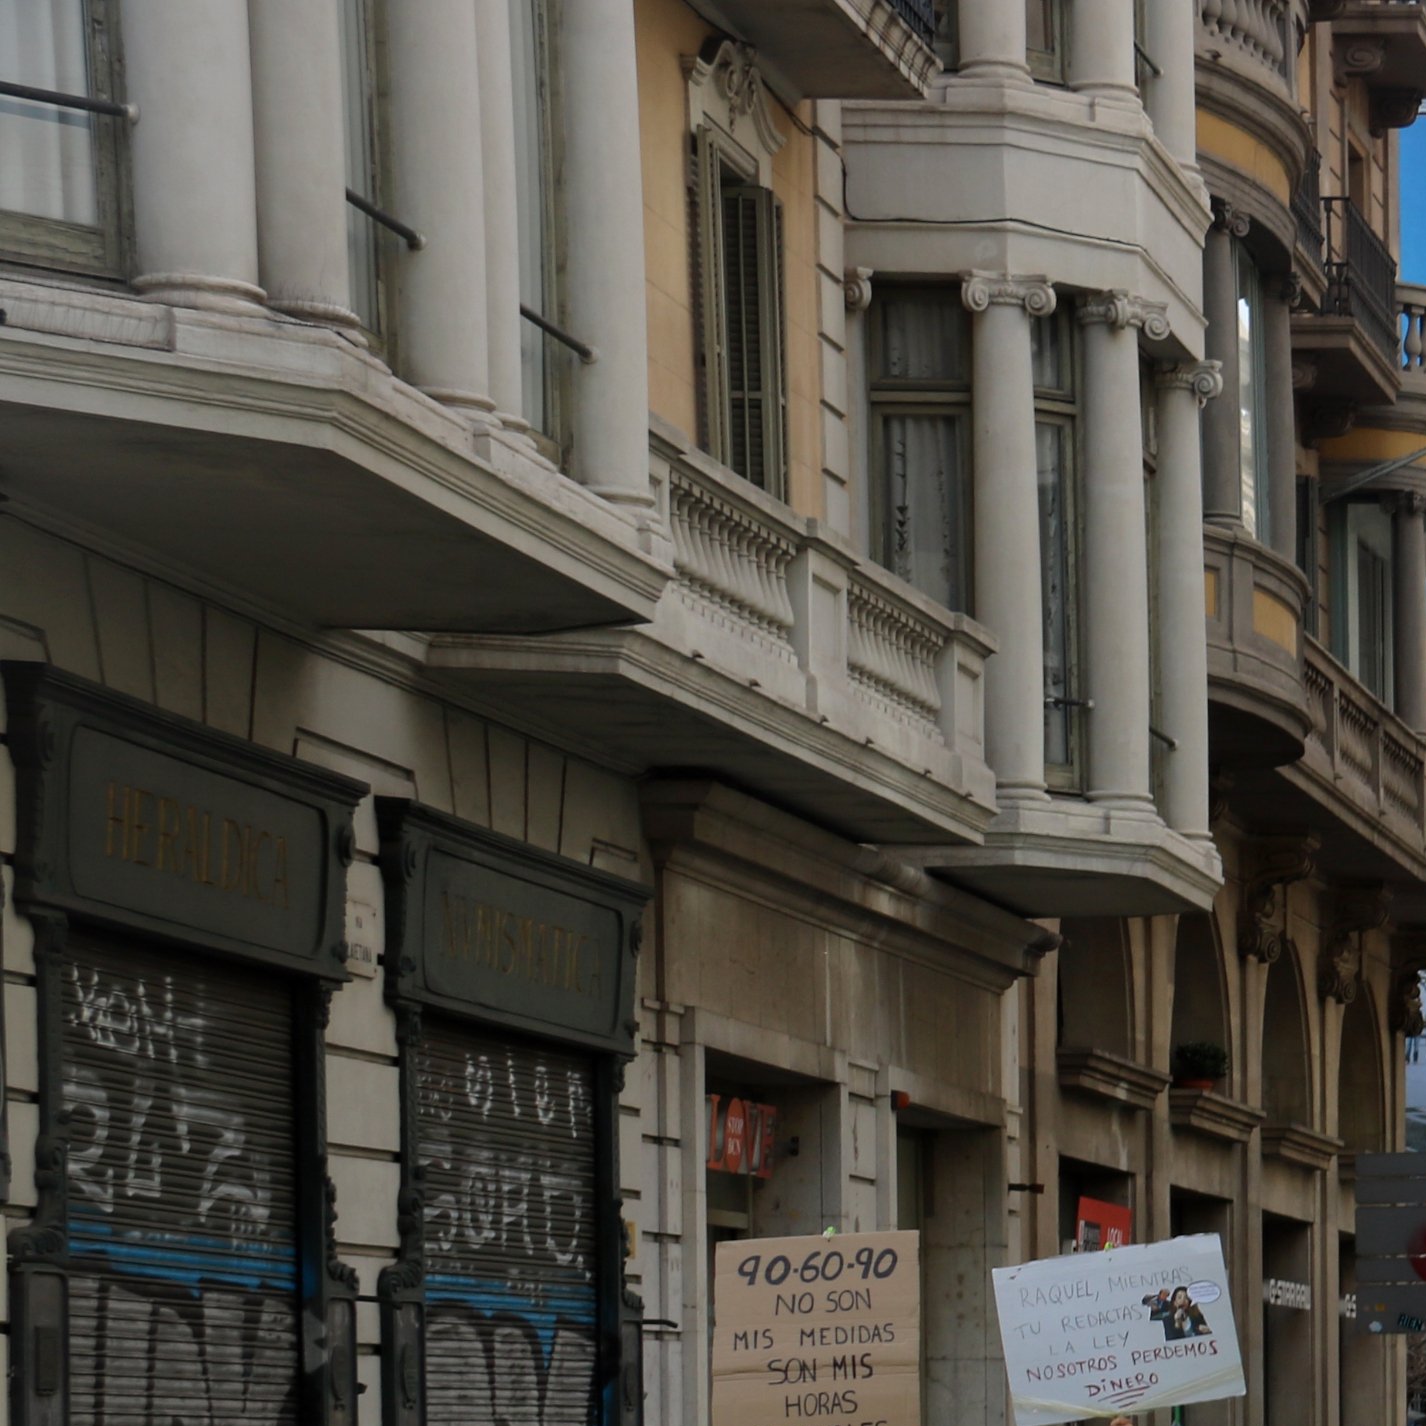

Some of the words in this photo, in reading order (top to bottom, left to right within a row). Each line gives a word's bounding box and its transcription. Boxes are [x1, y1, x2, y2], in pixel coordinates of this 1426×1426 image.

[104, 779, 290, 910] HERALDICA
[775, 1292, 815, 1316] NO
[825, 1288, 872, 1313] SON
[1061, 1304, 1143, 1334] REDACTAS
[734, 1328, 774, 1351] MIS
[800, 1322, 896, 1347] MEDIDAS
[1093, 1331, 1130, 1349] LEY
[768, 1358, 817, 1385] SON
[832, 1353, 874, 1381] MIS
[1027, 1355, 1118, 1383] NOSOTROS
[1131, 1339, 1219, 1366] PERDEMOS
[785, 1390, 858, 1418] HORAS
